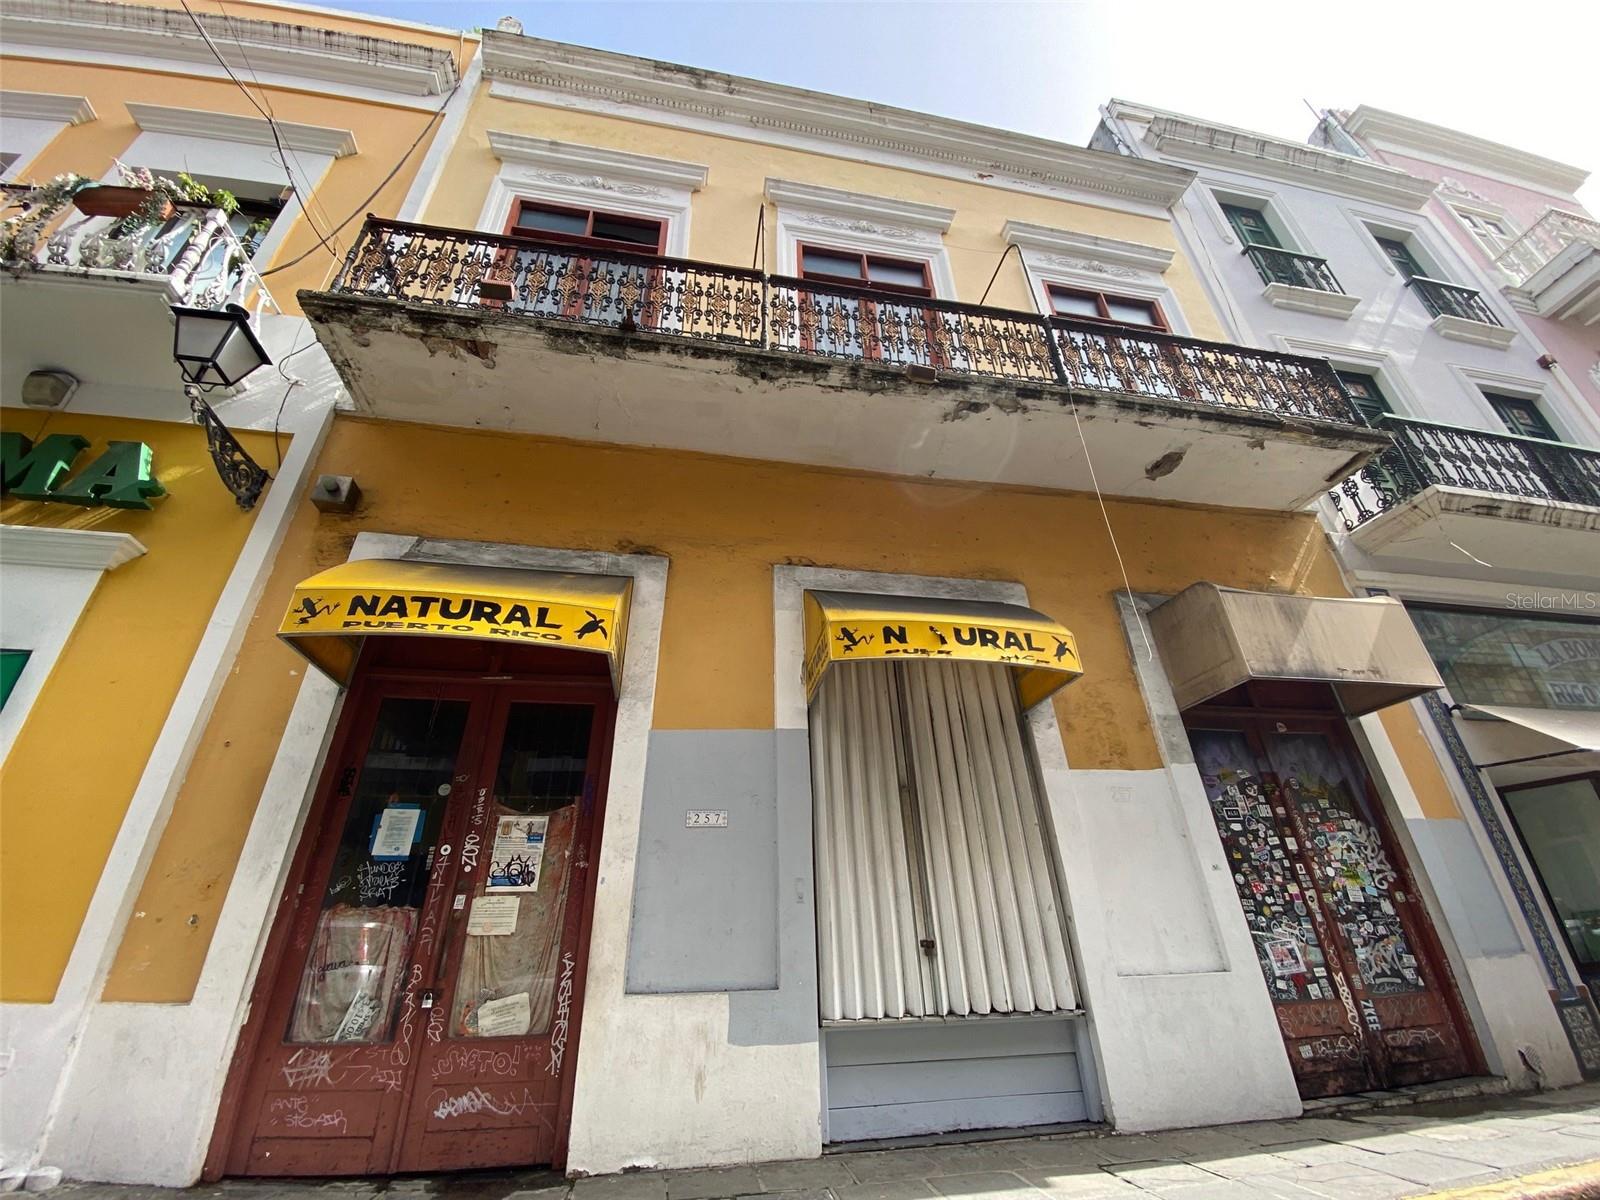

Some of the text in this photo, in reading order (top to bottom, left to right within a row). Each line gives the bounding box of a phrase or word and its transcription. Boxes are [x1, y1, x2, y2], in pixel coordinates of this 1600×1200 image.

[347, 595, 564, 630] NATURAL
[342, 620, 563, 642] PUERTO RICO
[693, 813, 721, 824] 257
